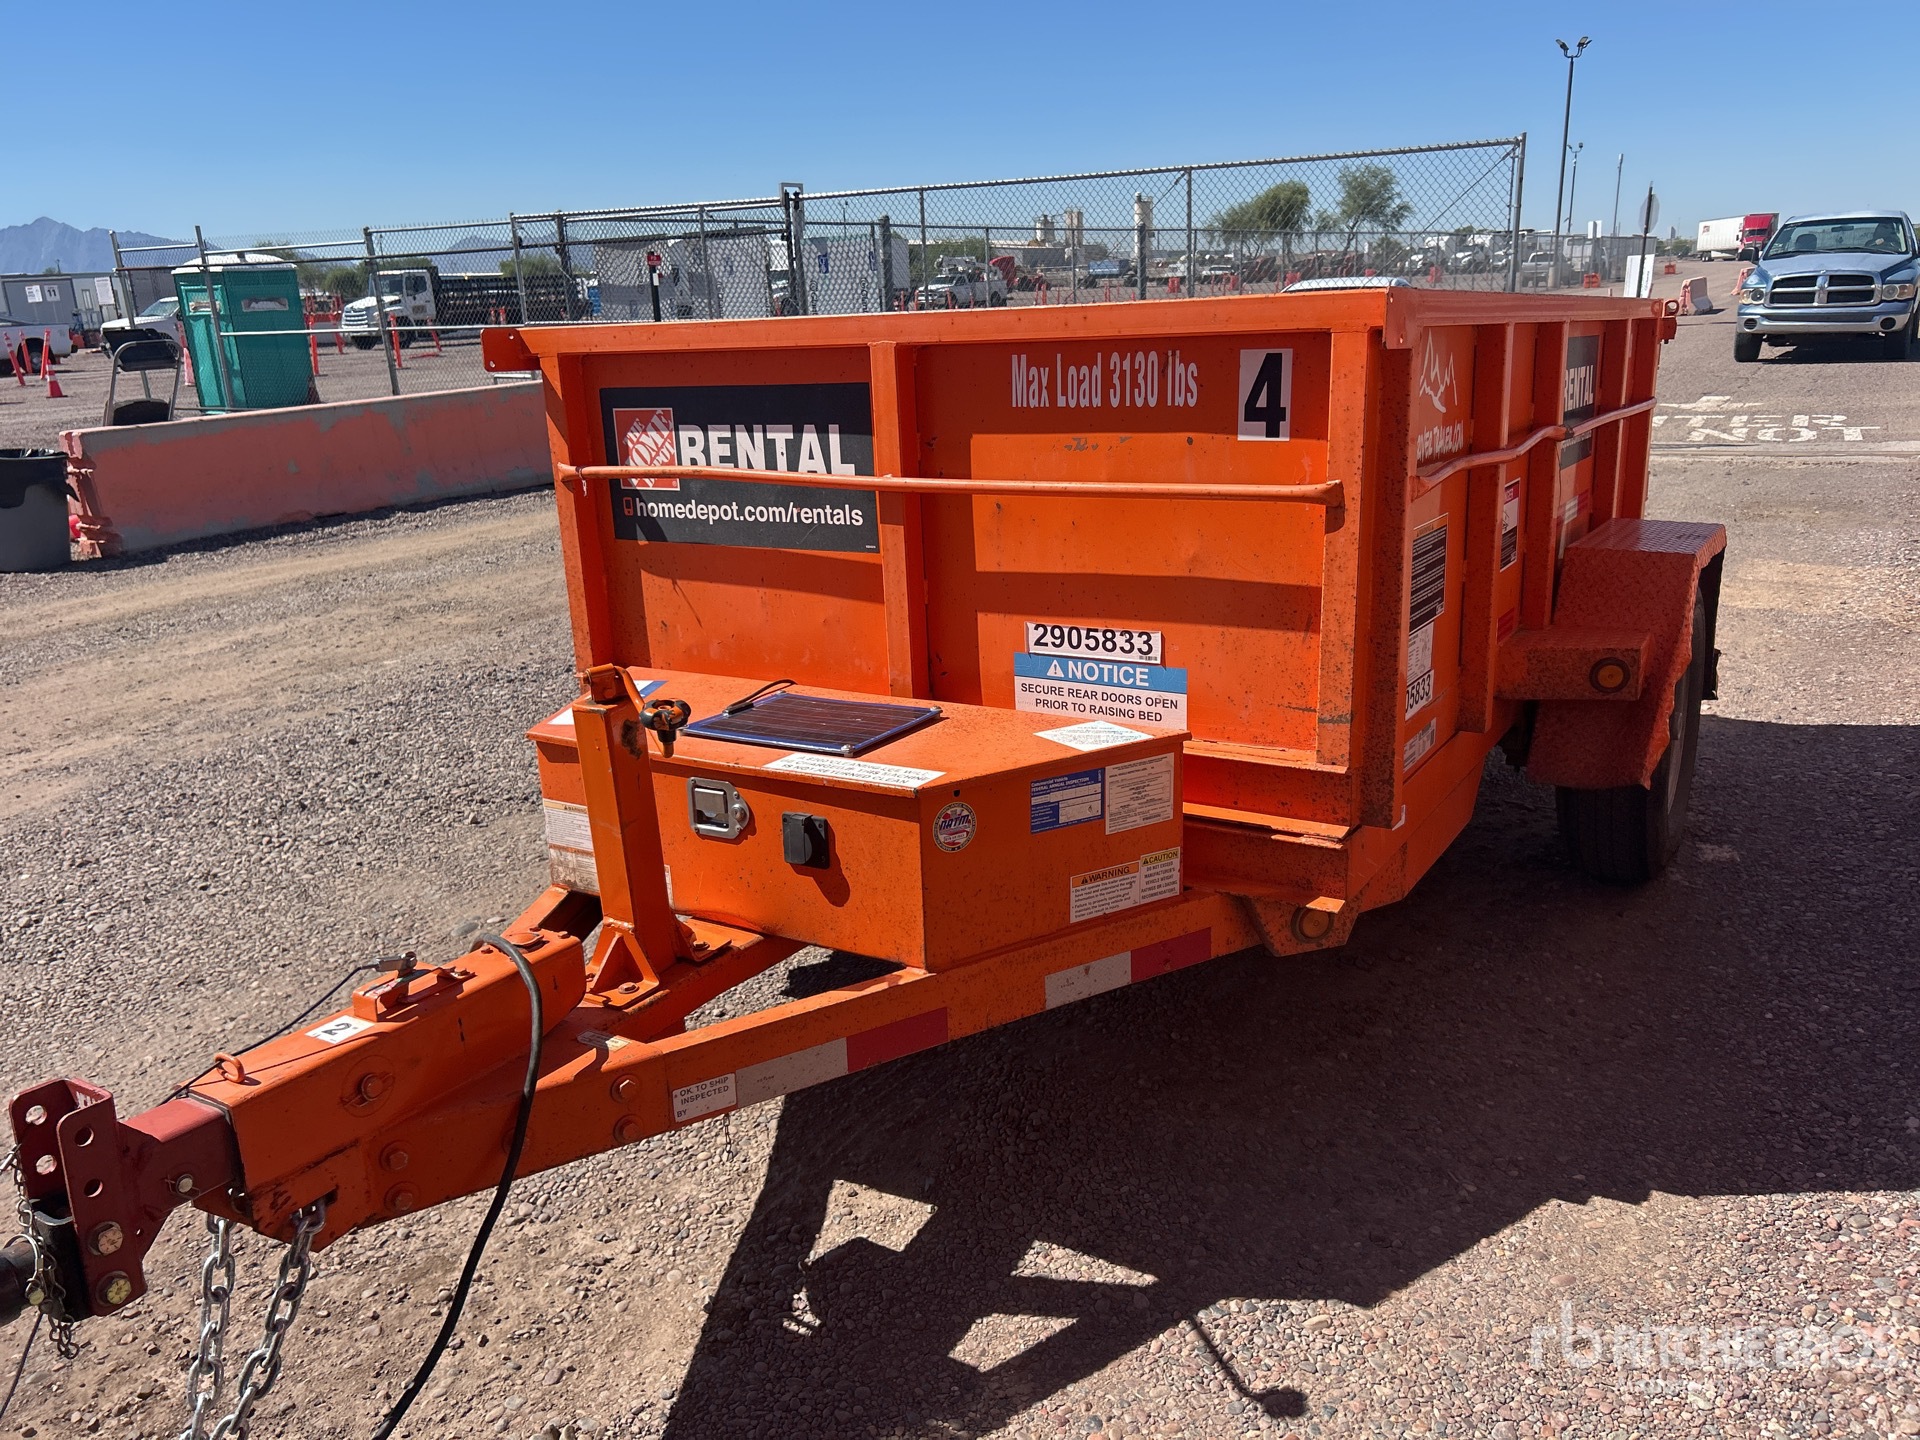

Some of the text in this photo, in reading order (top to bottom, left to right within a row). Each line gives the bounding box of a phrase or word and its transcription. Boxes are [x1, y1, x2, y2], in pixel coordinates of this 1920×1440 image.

[1012, 350, 1197, 408] Max Load 3130 lbs
[1564, 365, 1593, 412] RENTAL
[1244, 353, 1286, 438] 4
[1686, 426, 1880, 442] NOT
[678, 424, 855, 477] RENTAL
[636, 498, 864, 526] homedepot.com/rentals
[1033, 623, 1154, 656] 2905833
[1068, 660, 1149, 687] NOTICE
[1021, 682, 1178, 710] SECURE REAR DOORS OPEN
[1035, 698, 1162, 722] PRIOR TO RAISING BED
[1065, 776, 1089, 786] INSPECTION
[1149, 851, 1178, 864] CAUTION
[1089, 866, 1130, 882] WARNING
[321, 1022, 352, 1036] 2
[680, 1076, 729, 1096] OK TO SHIP
[681, 1085, 729, 1105] INSPECTED
[677, 1109, 687, 1118] BY
